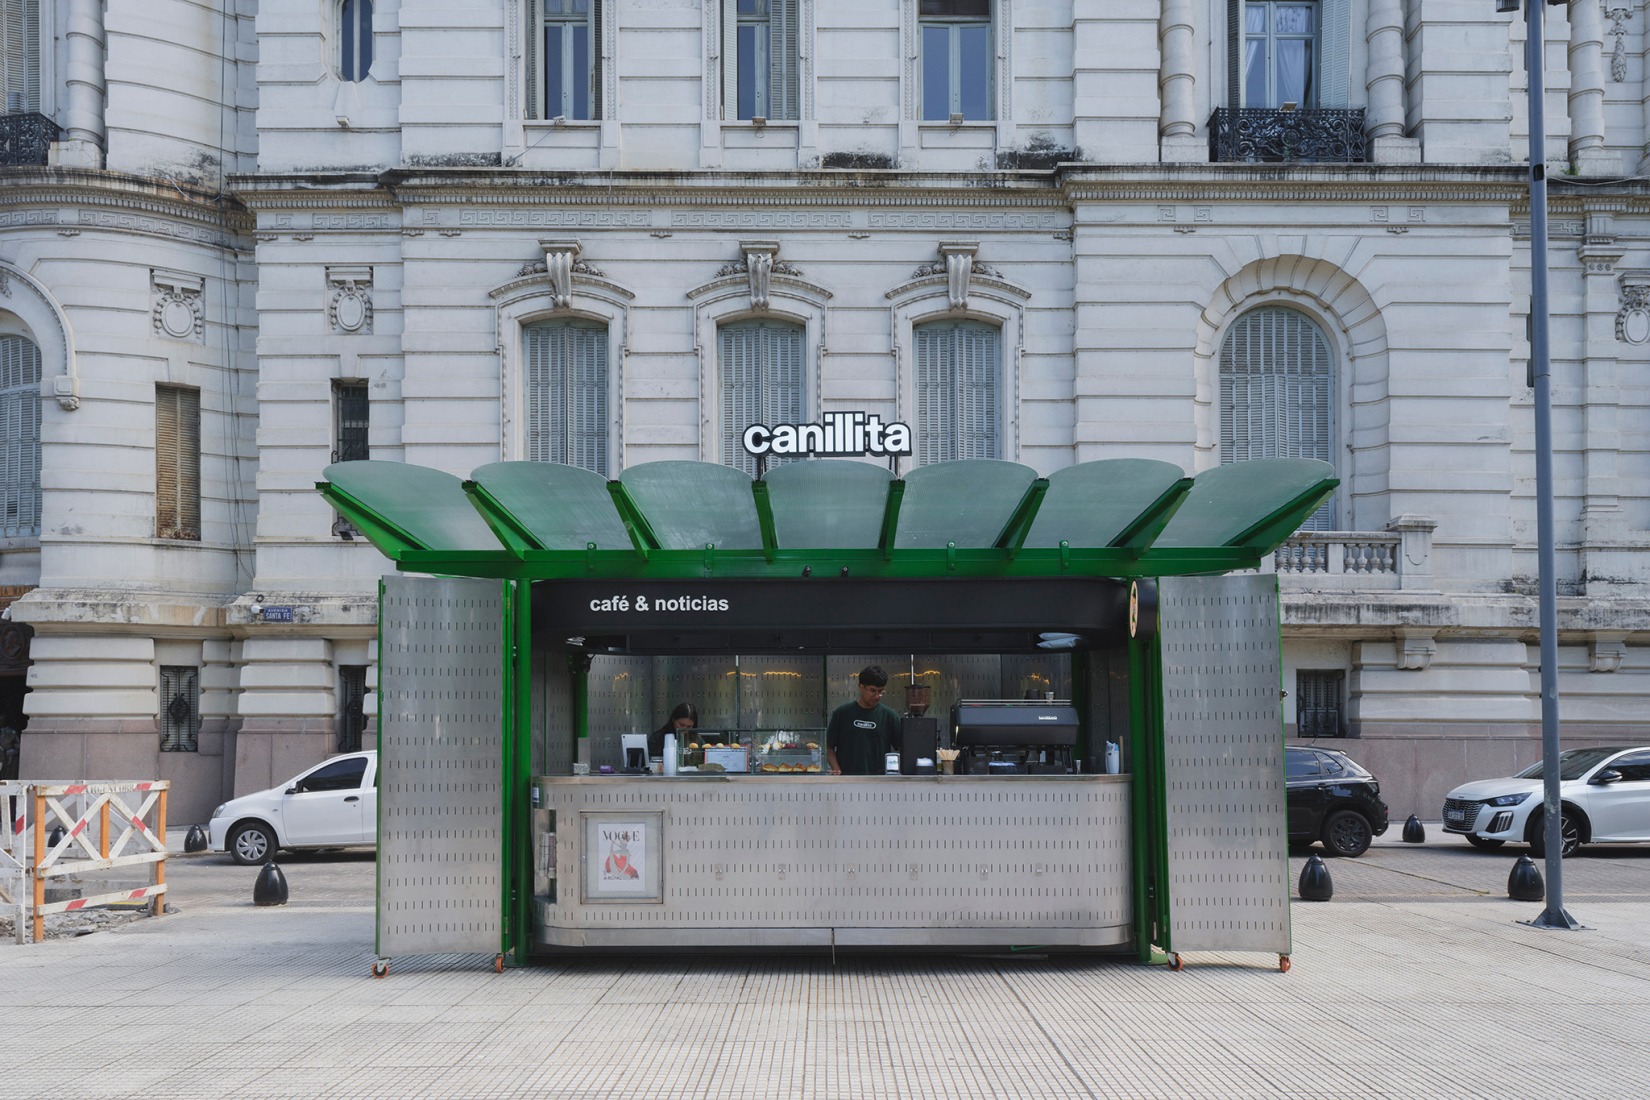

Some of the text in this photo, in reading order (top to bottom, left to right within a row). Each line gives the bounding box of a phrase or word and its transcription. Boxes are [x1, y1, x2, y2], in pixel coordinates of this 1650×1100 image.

[743, 412, 911, 455] canillita
[590, 595, 729, 612] café & noticias
